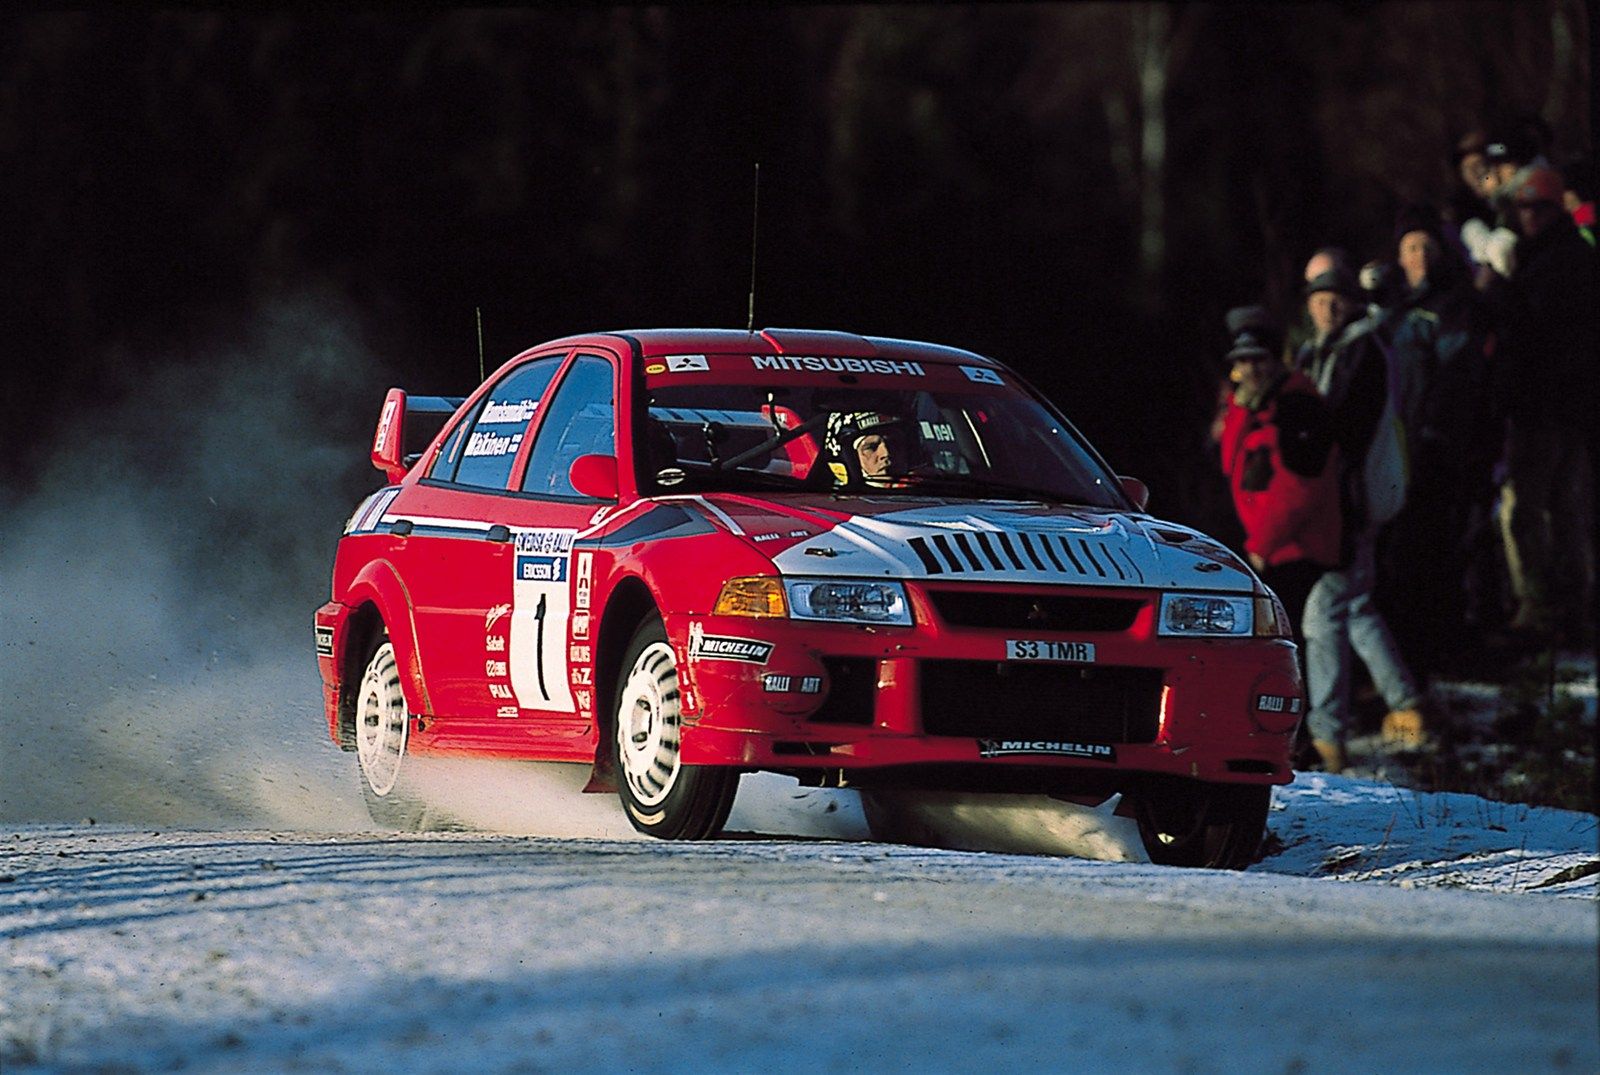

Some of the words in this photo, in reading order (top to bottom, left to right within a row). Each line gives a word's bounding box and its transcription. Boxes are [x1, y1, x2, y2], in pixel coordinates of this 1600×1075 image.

[751, 356, 926, 377] MITSUBISHI
[753, 533, 780, 542] RALLI
[533, 593, 551, 701] 1
[702, 639, 769, 657] MICHELIN
[1015, 641, 1039, 659] S3
[1046, 642, 1088, 661] TMR
[765, 676, 791, 692] RALLI
[801, 677, 821, 693] ART
[1258, 695, 1284, 712] RALLI
[1001, 741, 1112, 755] MICHELIN
